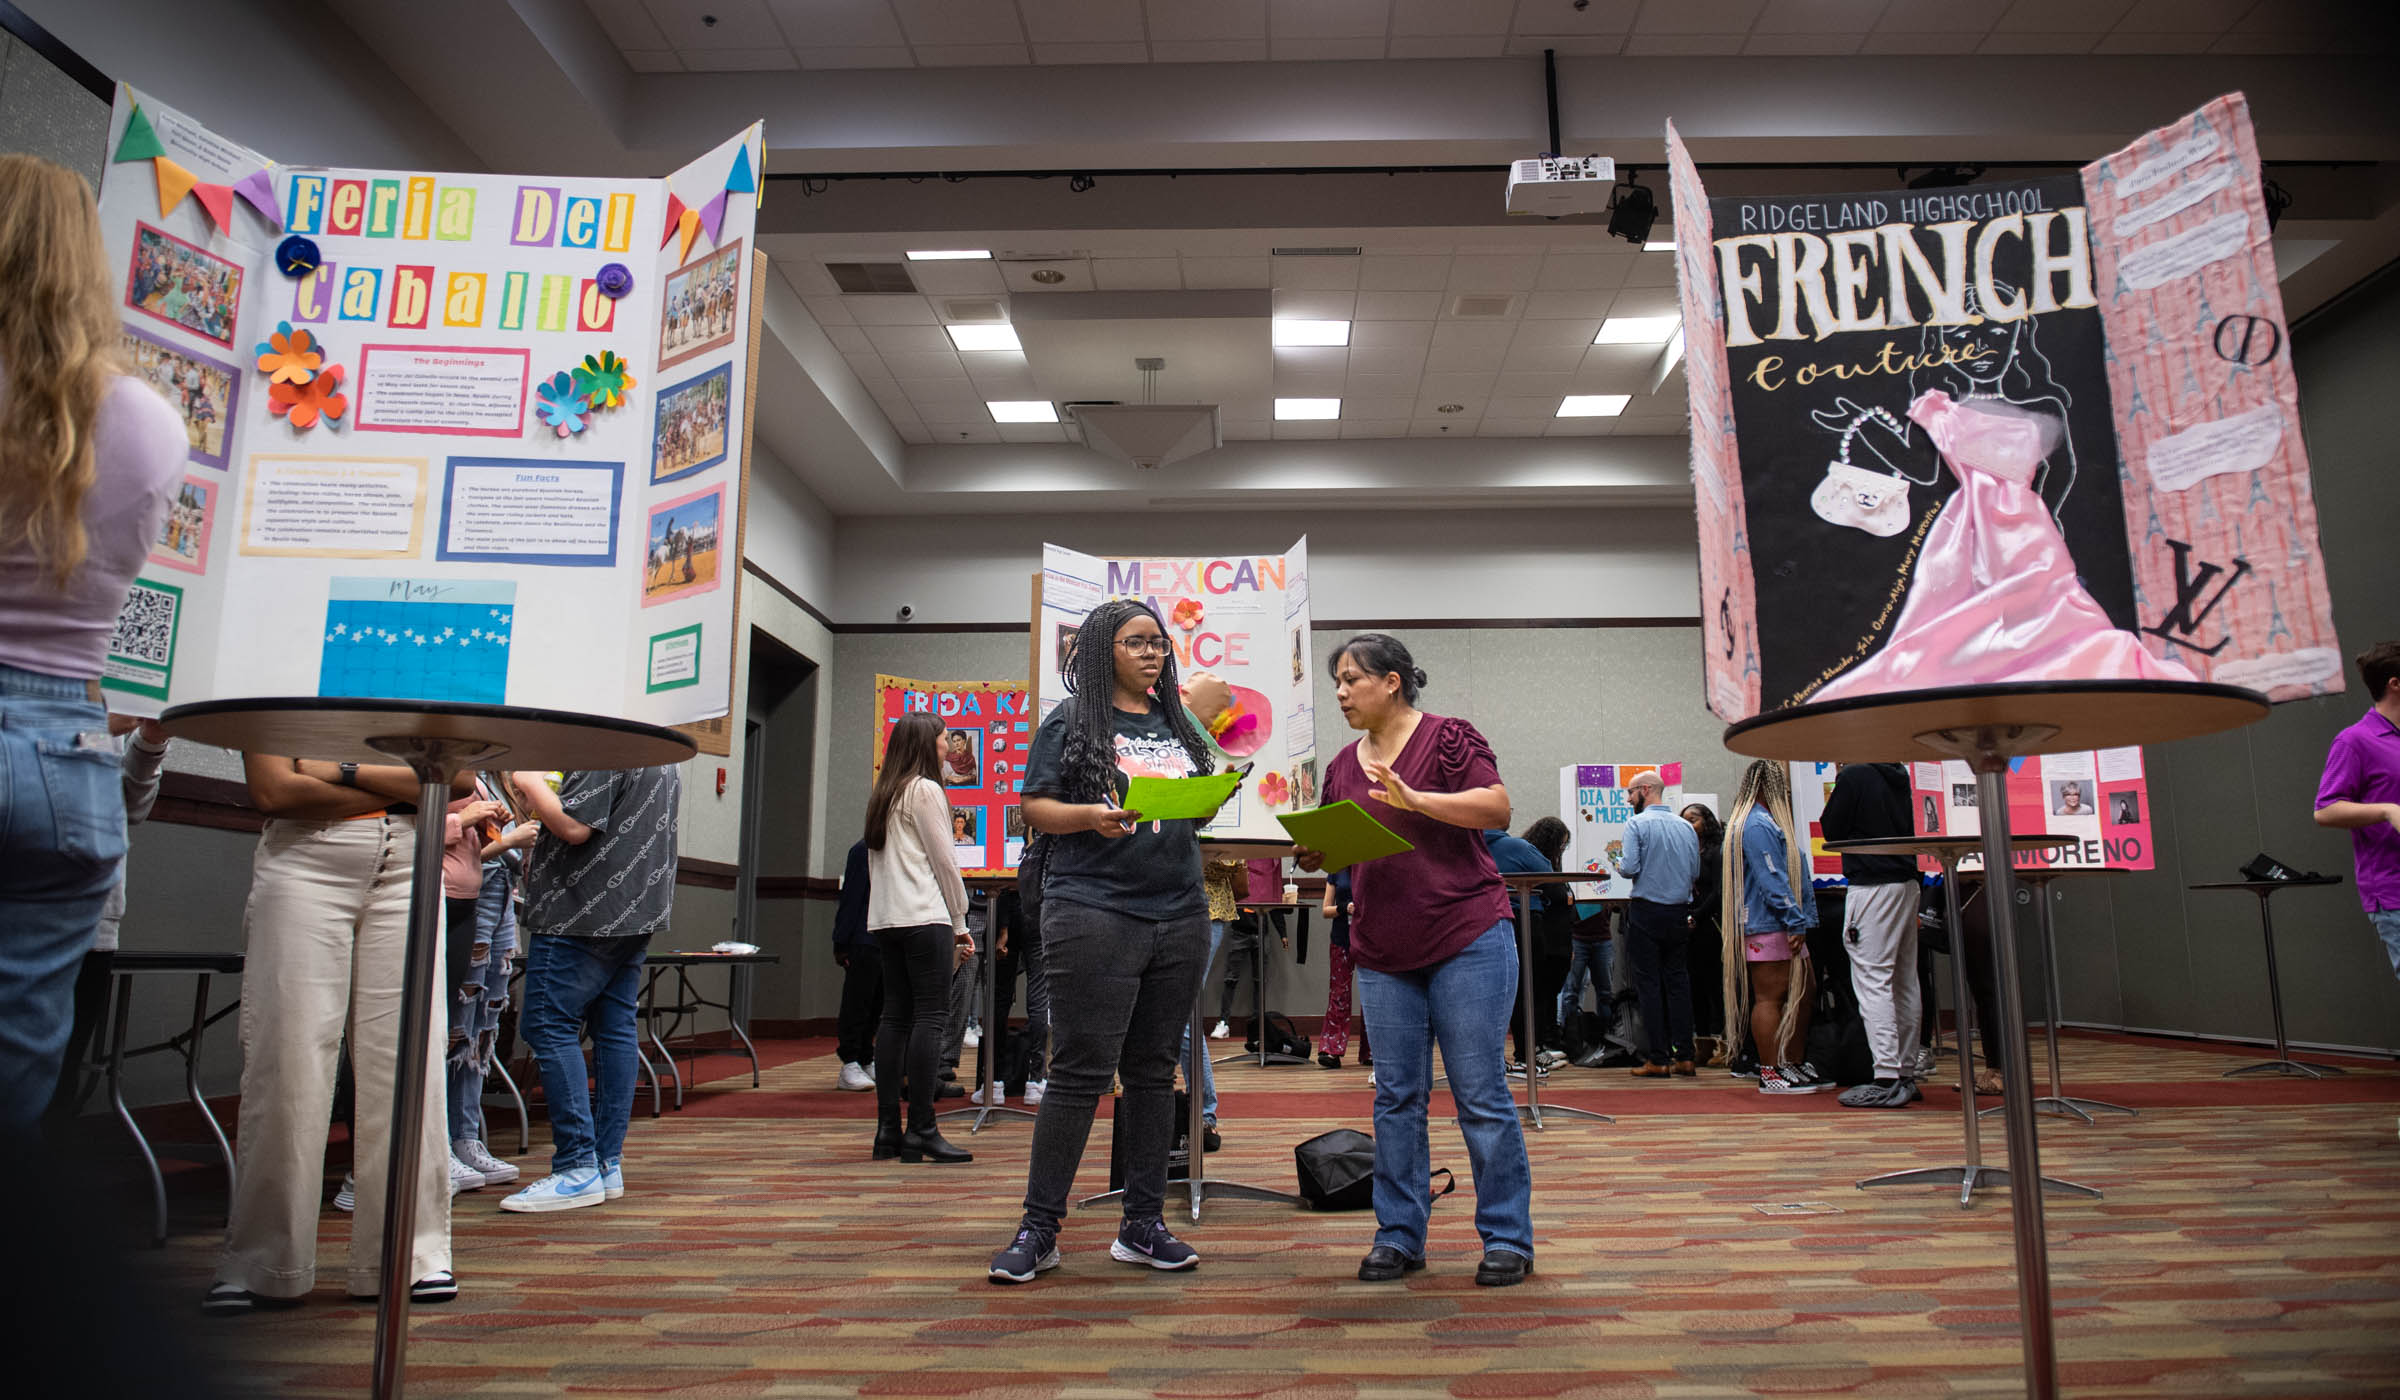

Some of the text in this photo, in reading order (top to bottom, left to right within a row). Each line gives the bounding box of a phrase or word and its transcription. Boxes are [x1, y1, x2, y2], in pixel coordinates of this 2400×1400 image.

[290, 177, 629, 249] Feria Del
[1741, 188, 2054, 231] RIDGELAND HIGHSCHOOL
[1713, 207, 2098, 347] FRENCH
[297, 264, 613, 330] Caballo
[413, 357, 486, 368] The Beginnings
[1747, 341, 1999, 391] Couture
[515, 473, 560, 483] Fun Facts
[1107, 558, 1286, 595] MEXICAN
[1897, 547, 1915, 576] Mary
[389, 579, 456, 601] May
[1168, 632, 1250, 668] NCE
[903, 691, 982, 717] FRIDA
[1580, 789, 1625, 806] DIA DE
[1595, 806, 1635, 823] MUERT
[606, 833, 657, 889] Champion
[2014, 837, 2142, 866] MORENO
